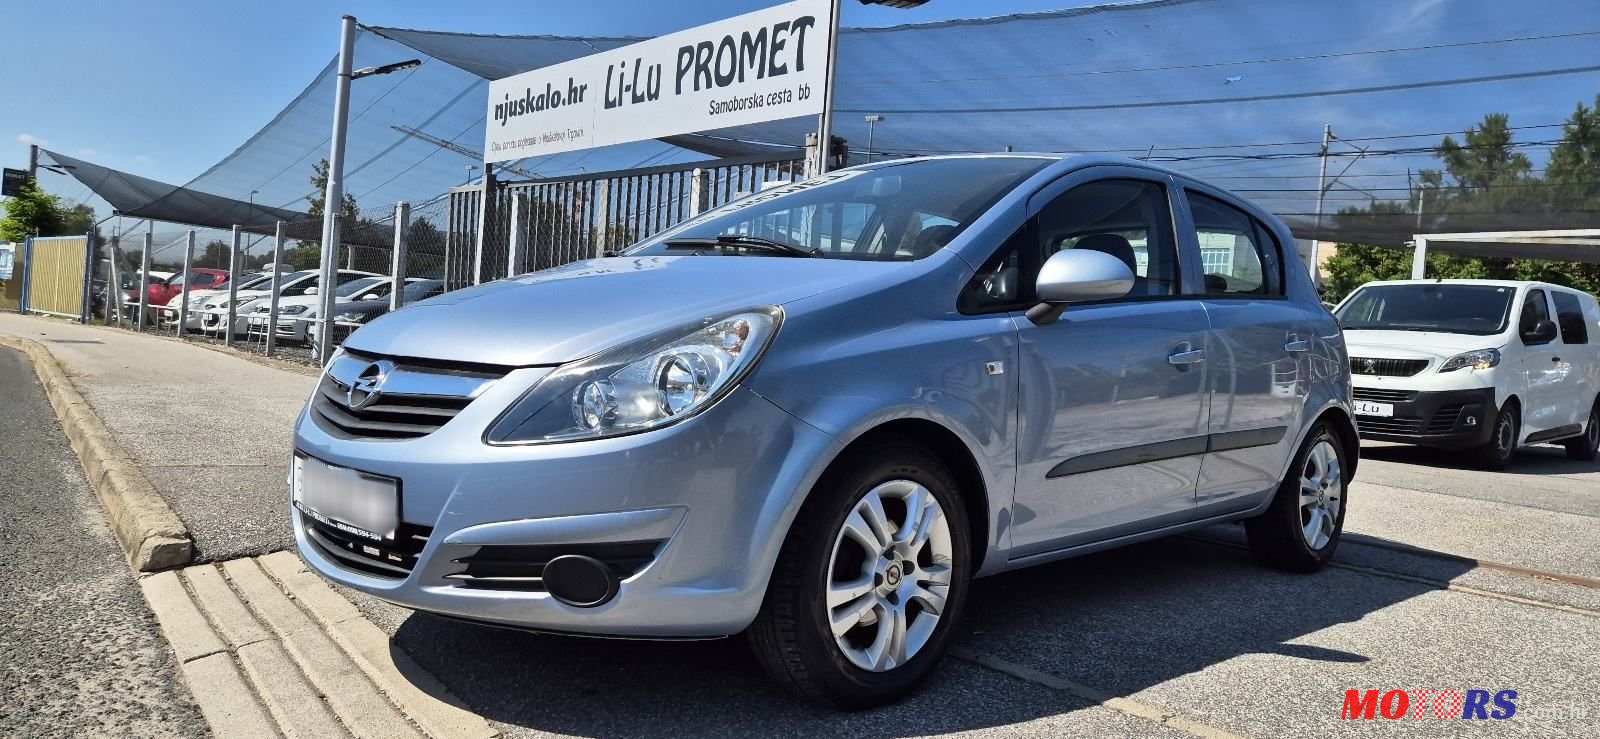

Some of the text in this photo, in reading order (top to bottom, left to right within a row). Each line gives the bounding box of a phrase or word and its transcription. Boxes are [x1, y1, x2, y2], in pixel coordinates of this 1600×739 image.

[604, 15, 815, 109] Li-Lu PROMET
[495, 77, 587, 127] njuskalo.hr
[709, 83, 811, 115] Samoborska cesta bb
